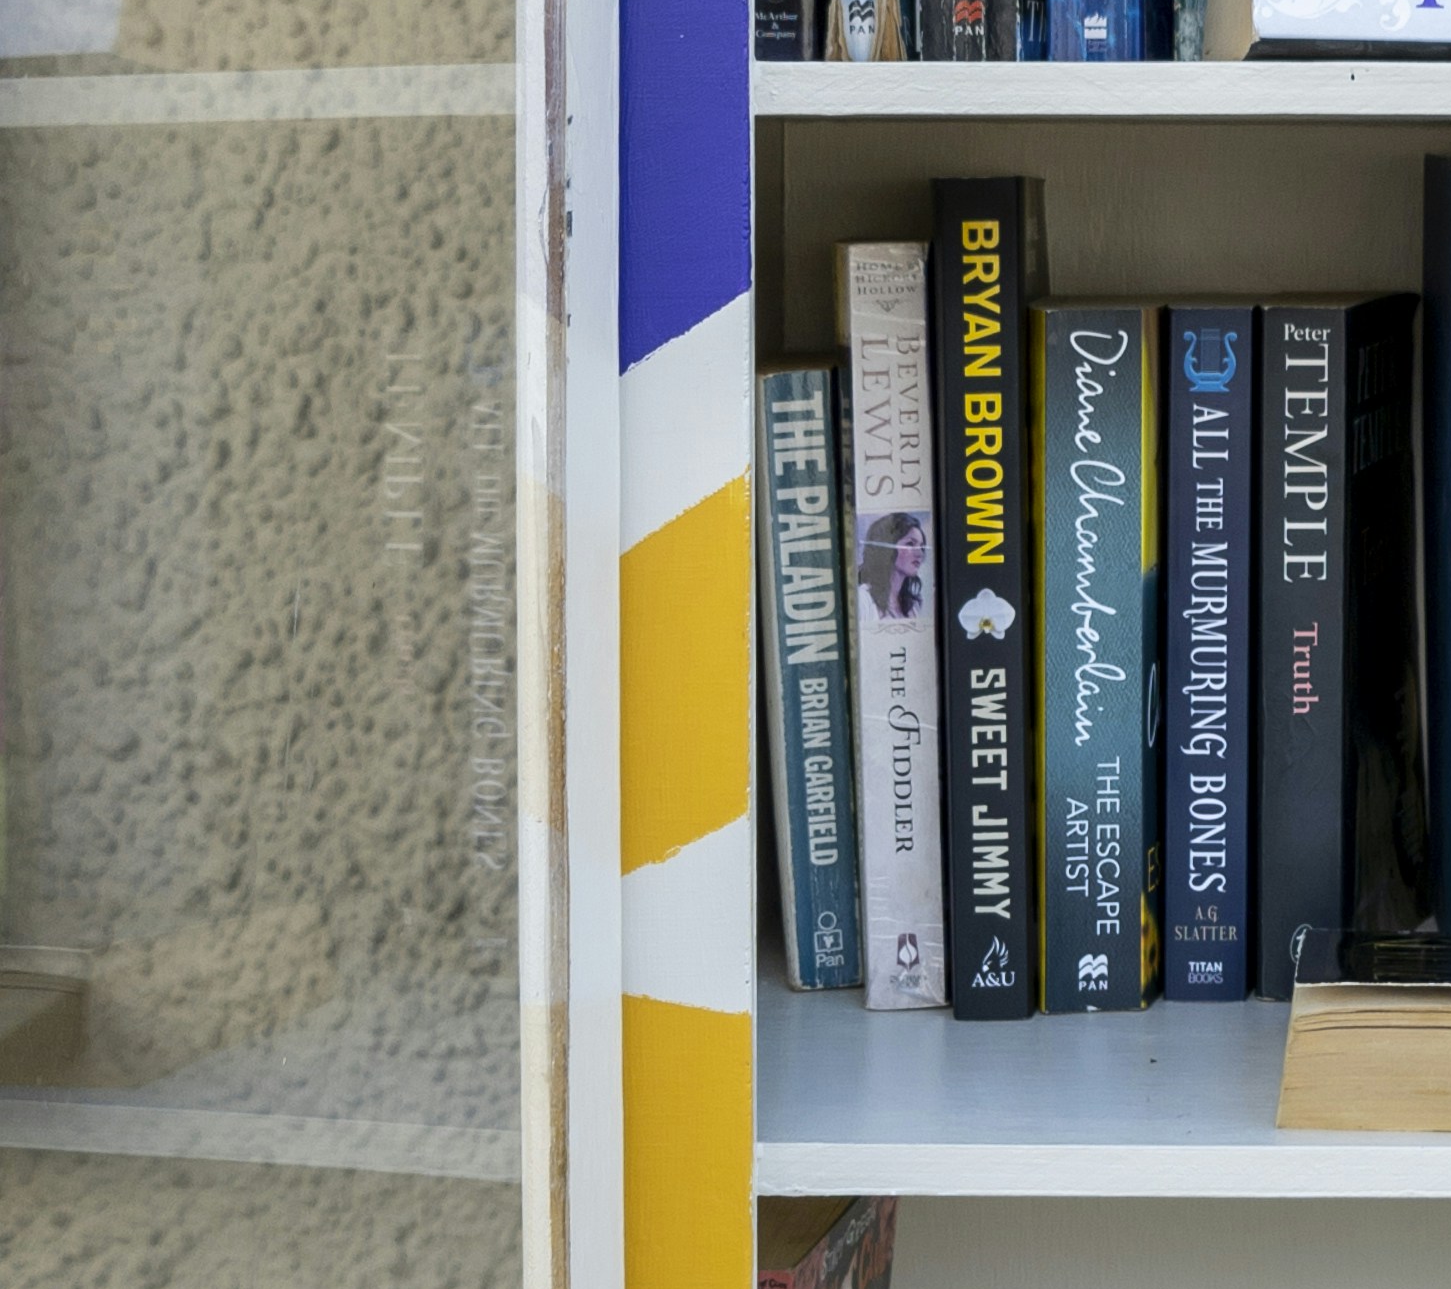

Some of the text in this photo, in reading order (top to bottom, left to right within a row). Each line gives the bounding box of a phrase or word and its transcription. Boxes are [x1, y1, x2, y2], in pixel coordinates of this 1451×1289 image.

[849, 25, 876, 35] PAN
[954, 25, 984, 36] PAN
[857, 285, 917, 295] HOLLOW
[1283, 323, 1331, 342] Peter
[860, 336, 895, 499] LEWIS
[897, 332, 922, 496] BEVERLY
[961, 219, 1005, 564] BRYAN BROWN
[1283, 343, 1329, 583] TEMPLE
[1070, 329, 1129, 747] Diane Chamberlain
[771, 390, 839, 866] THE PALADIN BRIAN GARFIELD
[1180, 402, 1229, 894] ALL THE MURMURING BONES
[1293, 622, 1320, 716] Truth
[888, 647, 921, 854] THE FIDDLER
[970, 667, 1011, 920] SWEET JIMMY
[1065, 798, 1089, 897] ARTIST
[1096, 756, 1120, 936] THE ESCAPE
[815, 953, 845, 968] Pan
[971, 971, 1016, 988] A&U
[1174, 925, 1239, 942] SLATTER
[1188, 961, 1224, 973] TITAN
[1188, 973, 1224, 985] BOOKS
[1078, 980, 1109, 992] PAN
